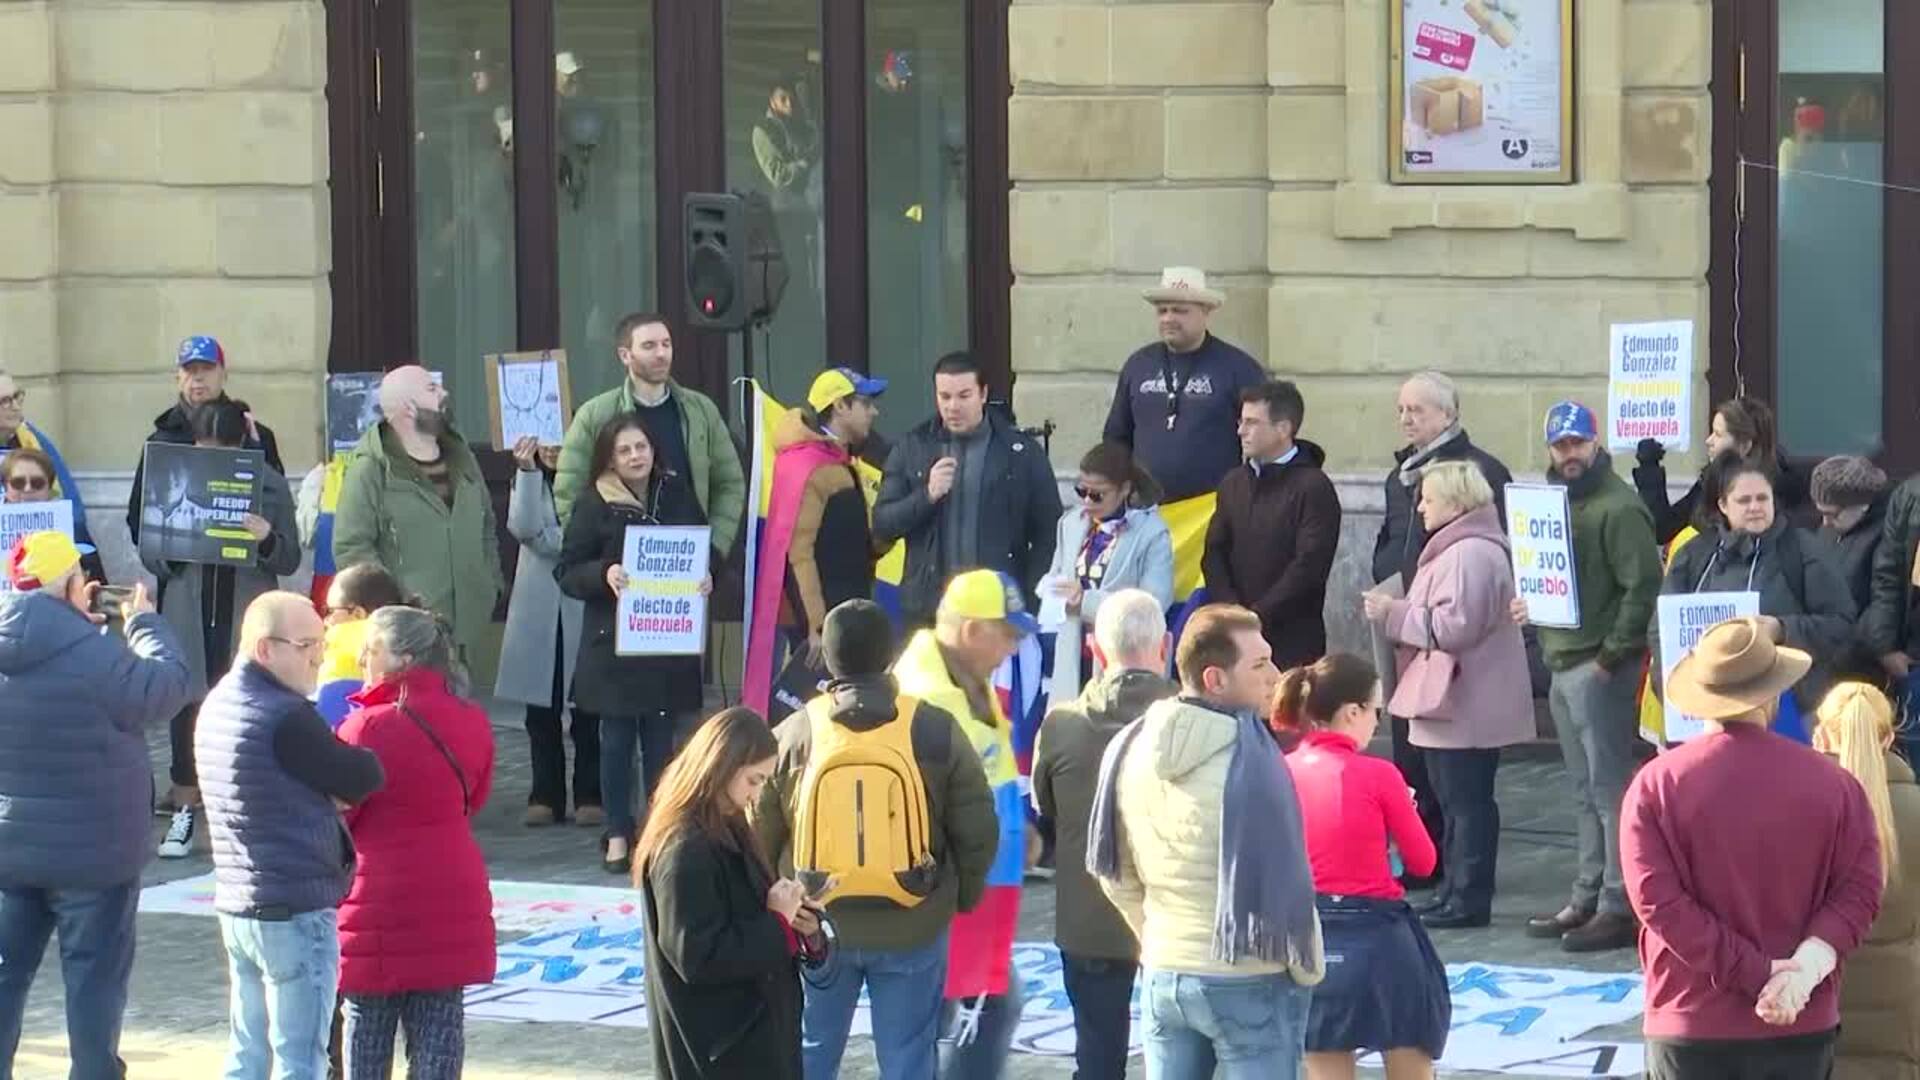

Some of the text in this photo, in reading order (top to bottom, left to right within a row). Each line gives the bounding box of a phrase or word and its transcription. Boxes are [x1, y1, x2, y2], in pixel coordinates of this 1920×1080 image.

[1622, 334, 1679, 354] Edmundo
[1622, 352, 1677, 373] González
[1620, 399, 1676, 418] electo de
[1616, 418, 1679, 437] Venezuela
[638, 536, 696, 555] Edmundo
[636, 553, 693, 573] González
[1519, 576, 1569, 598] pueblo
[632, 597, 691, 615] electo de
[628, 614, 693, 634] Venezuela
